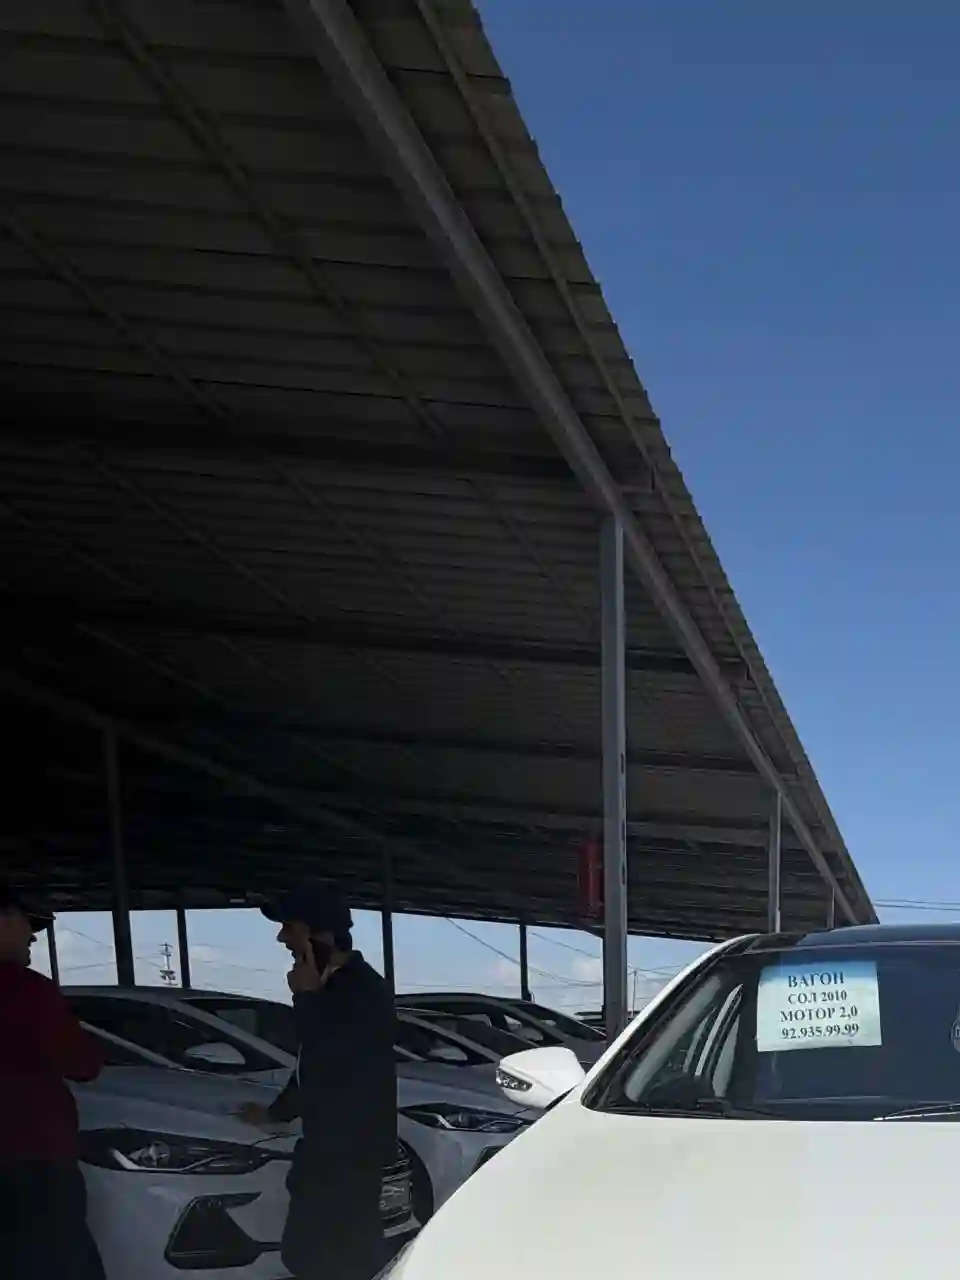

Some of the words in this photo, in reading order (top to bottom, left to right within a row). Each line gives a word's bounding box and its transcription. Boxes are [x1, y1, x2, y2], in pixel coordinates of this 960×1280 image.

[787, 971, 845, 988] ВАГОН
[788, 992, 817, 1004] СОЛ
[821, 989, 848, 1002] 2010
[780, 1007, 836, 1023] МОТОР
[839, 1005, 858, 1020] 2,0
[781, 1023, 860, 1039] 92.935.99.99
